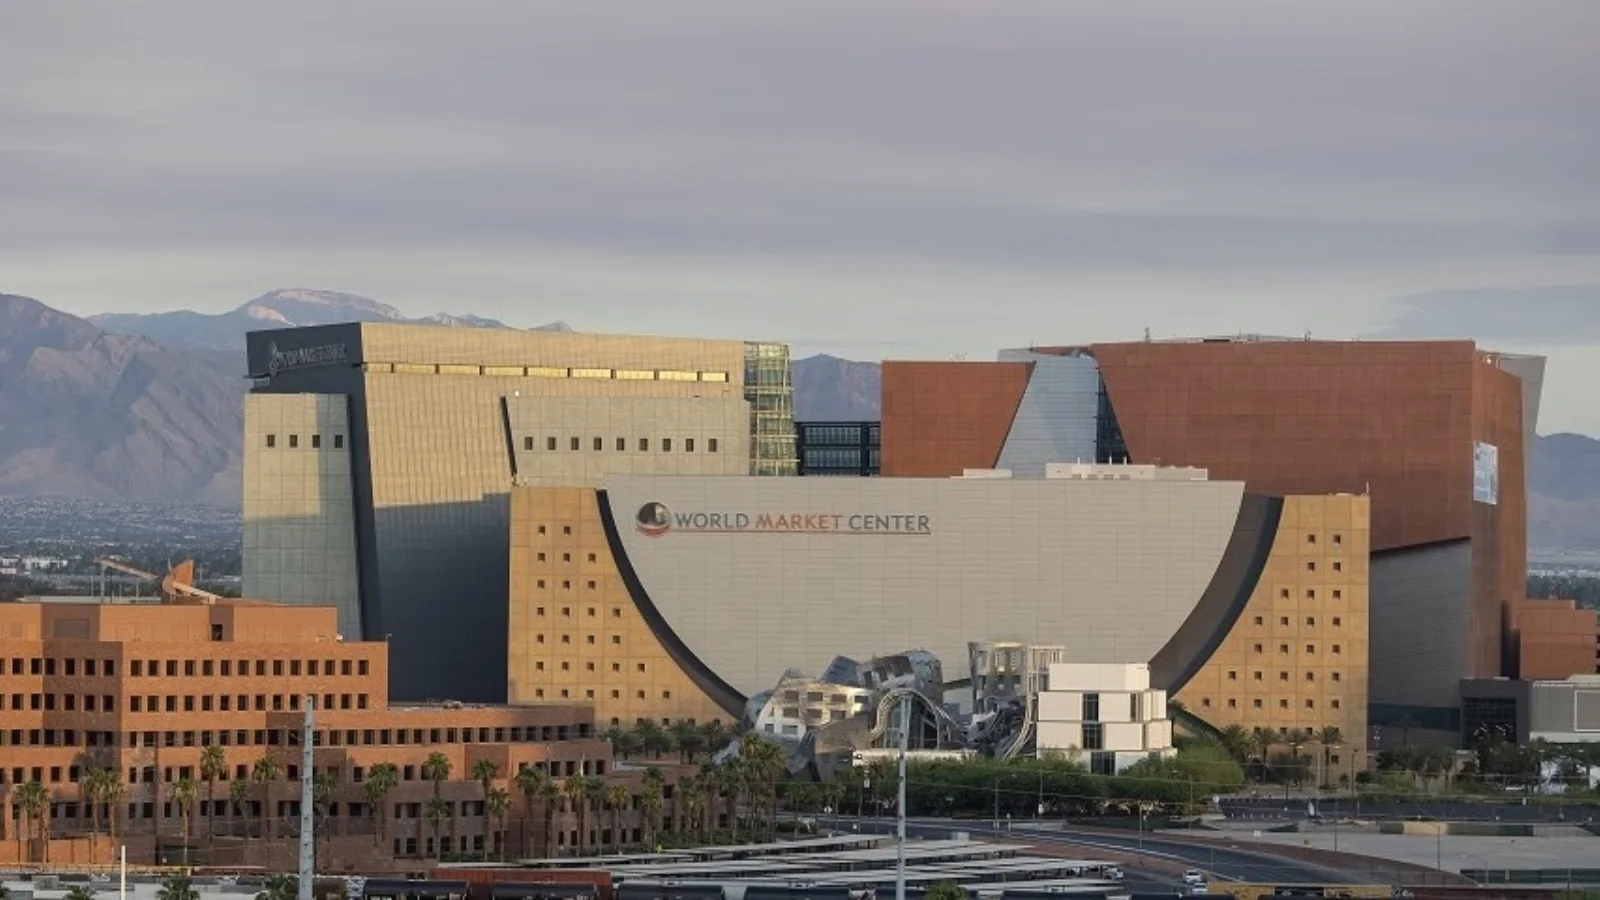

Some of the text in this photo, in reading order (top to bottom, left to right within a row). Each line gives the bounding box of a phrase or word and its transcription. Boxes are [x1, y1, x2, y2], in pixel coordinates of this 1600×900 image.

[676, 511, 932, 532] WORLD MARKET CENTER
